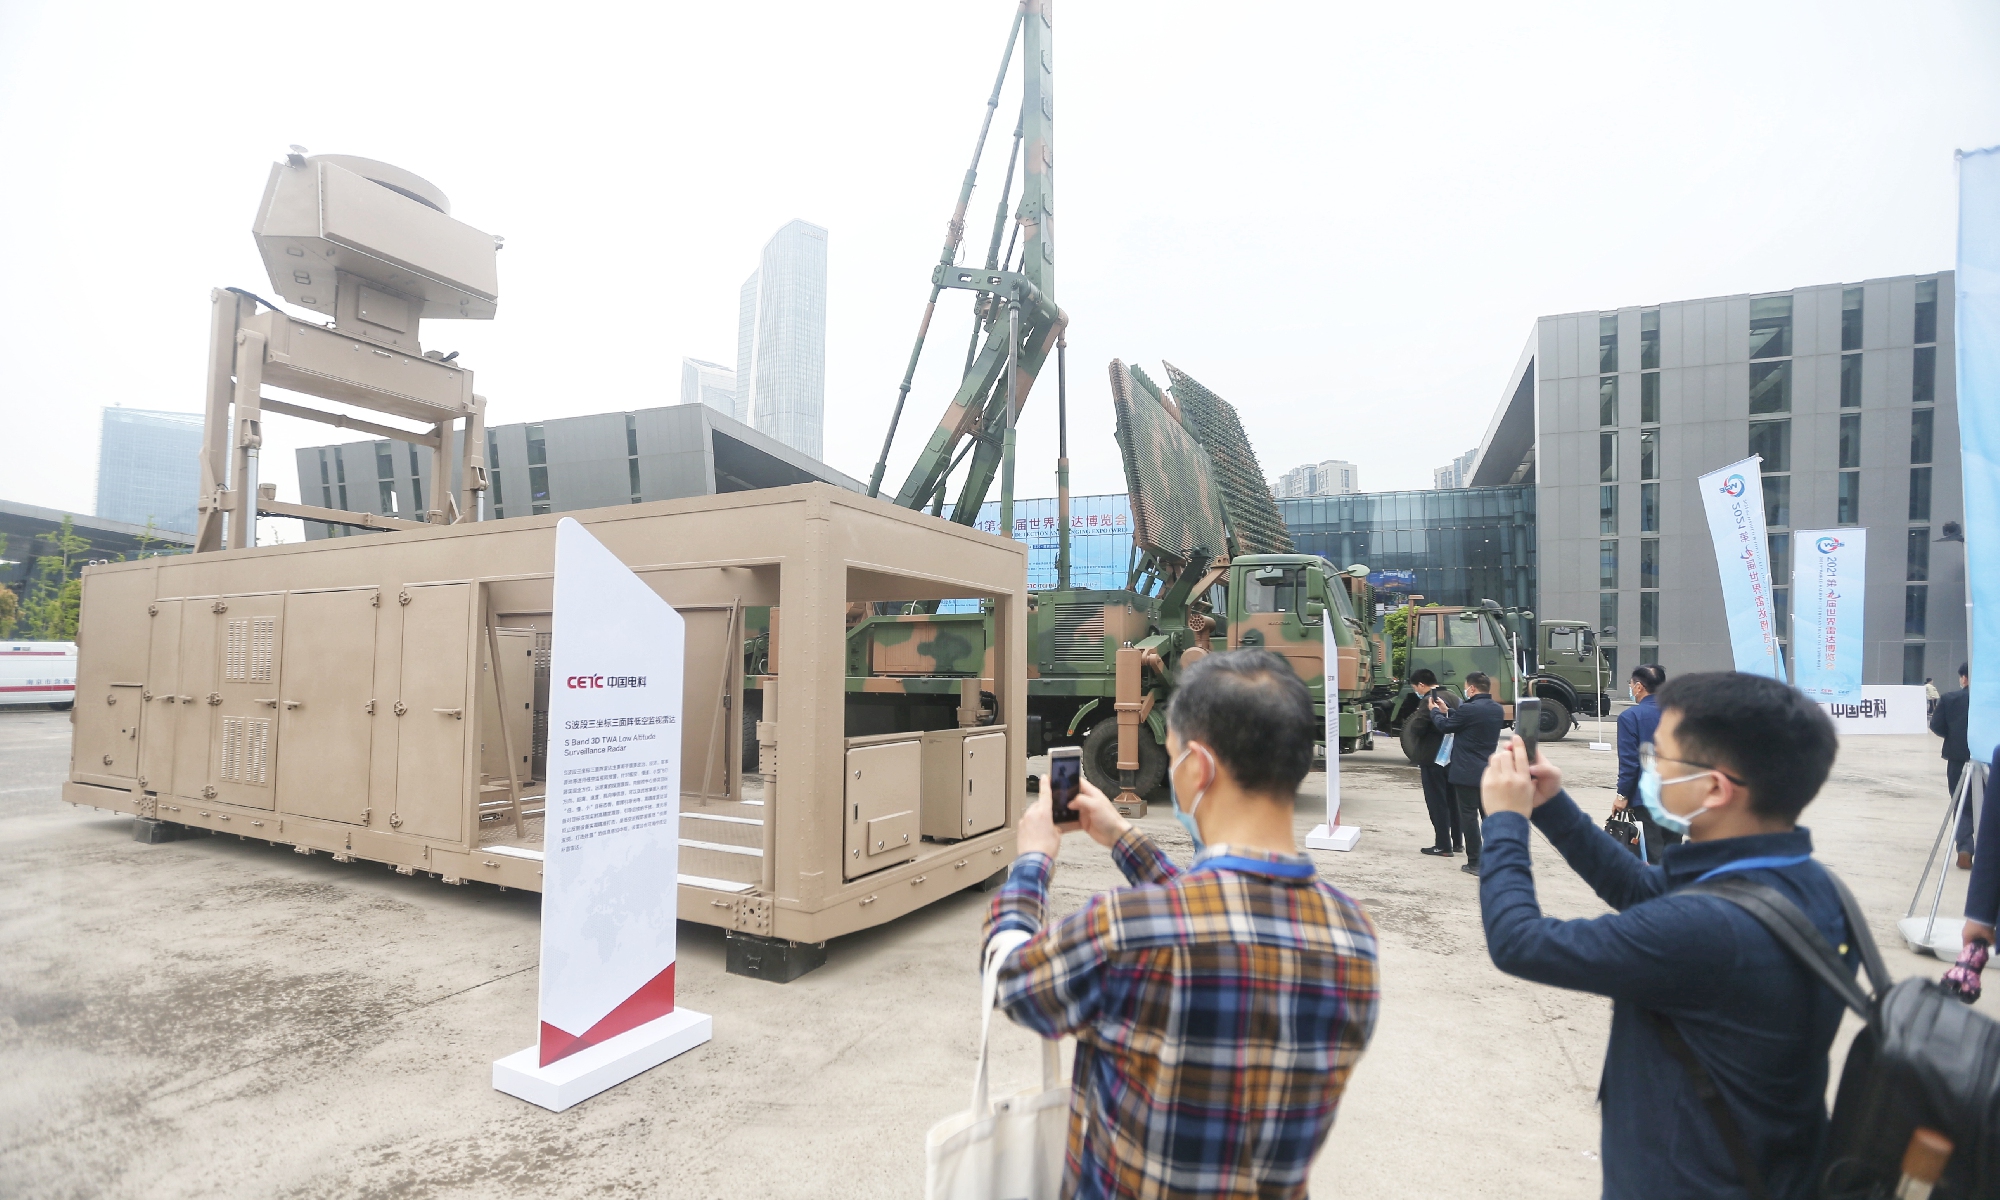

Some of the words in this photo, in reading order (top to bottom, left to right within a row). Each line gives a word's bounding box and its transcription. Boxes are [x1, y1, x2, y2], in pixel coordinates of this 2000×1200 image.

[567, 673, 604, 689] CETC
[607, 676, 647, 688] 中国电科
[1831, 698, 1887, 719] 中国电科
[564, 739, 570, 747] S
[572, 737, 590, 746] Band
[590, 736, 601, 745] 3D
[602, 735, 617, 744] TWA
[619, 735, 631, 743] Low
[633, 733, 656, 741] Altitude
[564, 747, 606, 757] Surveillance
[607, 745, 627, 753] Radar
